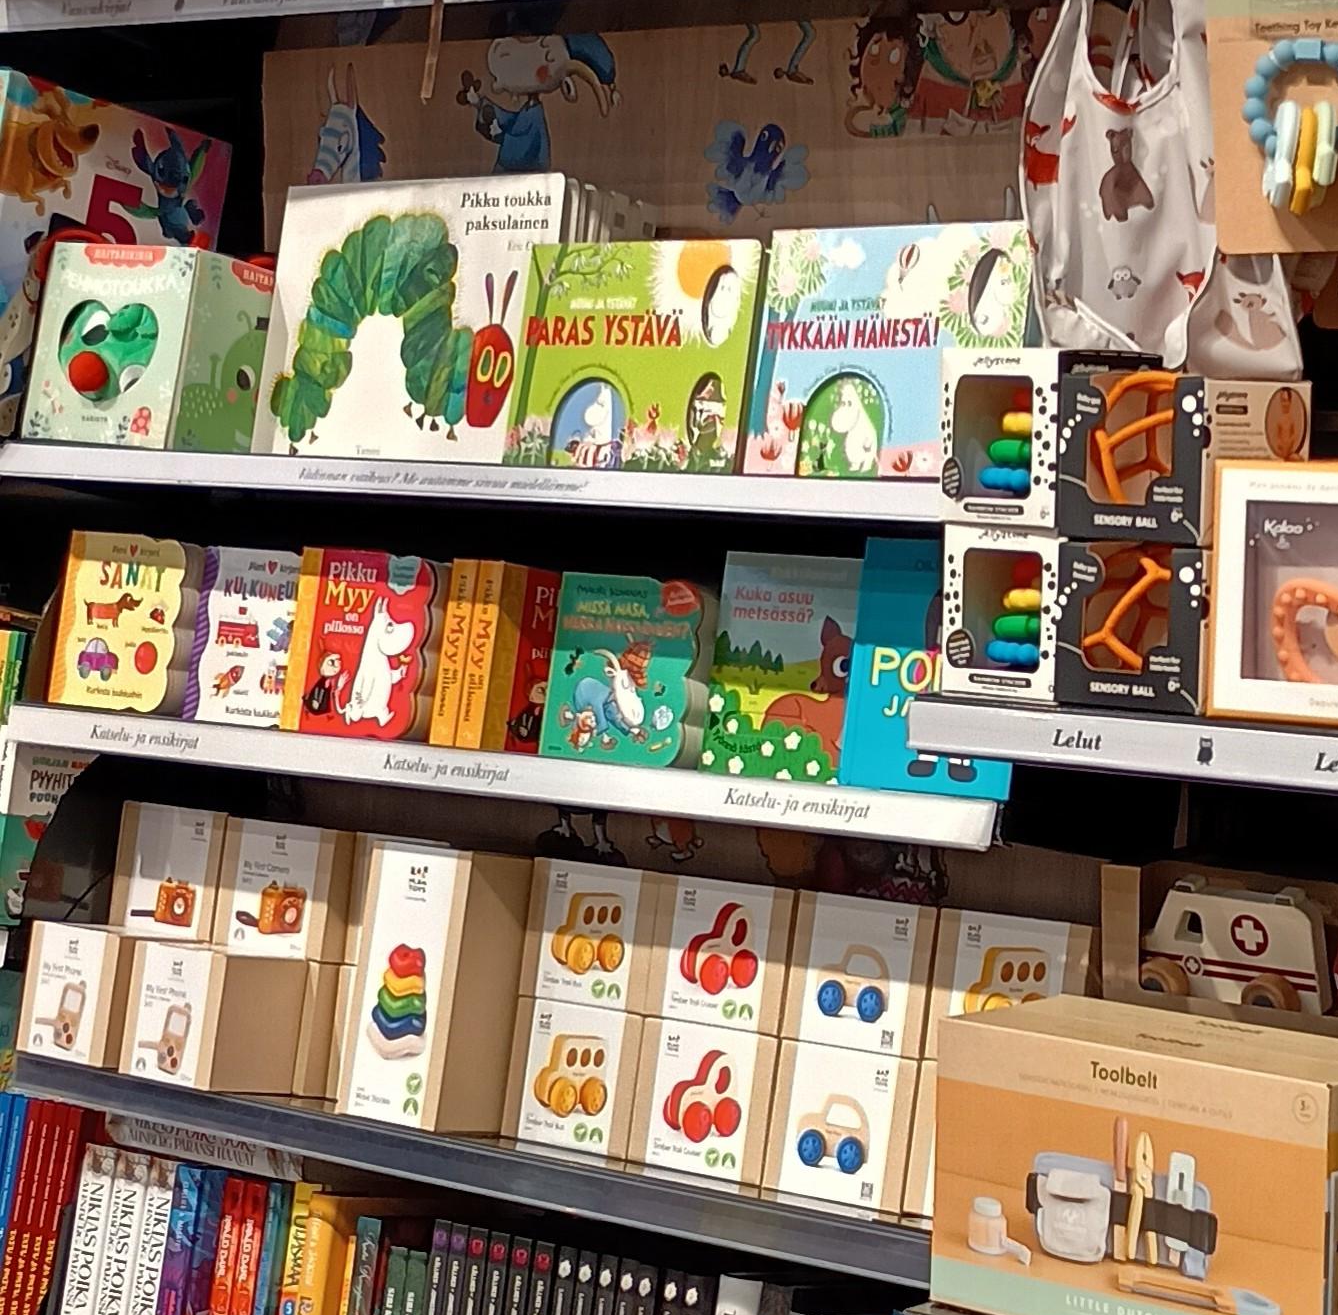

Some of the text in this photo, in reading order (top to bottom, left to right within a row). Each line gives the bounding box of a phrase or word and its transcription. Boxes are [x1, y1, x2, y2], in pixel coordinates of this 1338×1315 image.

[1255, 21, 1300, 36] Teething
[1303, 19, 1321, 34] Toy
[461, 191, 552, 211] Pikku toukka
[465, 212, 550, 234] paksulainen
[61, 268, 178, 298] PEHMOTOUKKA
[525, 307, 683, 348] PARAS YSTÄVÄ
[767, 314, 940, 350] TYKKÄÄN HÄNESTÄ!
[1093, 513, 1159, 530] SENSORY BALL
[1264, 517, 1306, 538] Kaloo
[328, 561, 378, 584] Pikku
[324, 580, 375, 610] Myy
[733, 586, 815, 606] Kuka asuu
[731, 605, 815, 625] metsässä?
[1129, 682, 1155, 698] BALL
[89, 724, 200, 752] Katselu- ja ensikirjat
[1052, 728, 1102, 752] Lelut
[382, 753, 510, 784] Katselu- ja ensikirjat
[722, 787, 871, 821] Katselu- ja ensikirjat
[1090, 1059, 1159, 1091] Toolbelt
[1065, 1292, 1113, 1315] LITTLE
